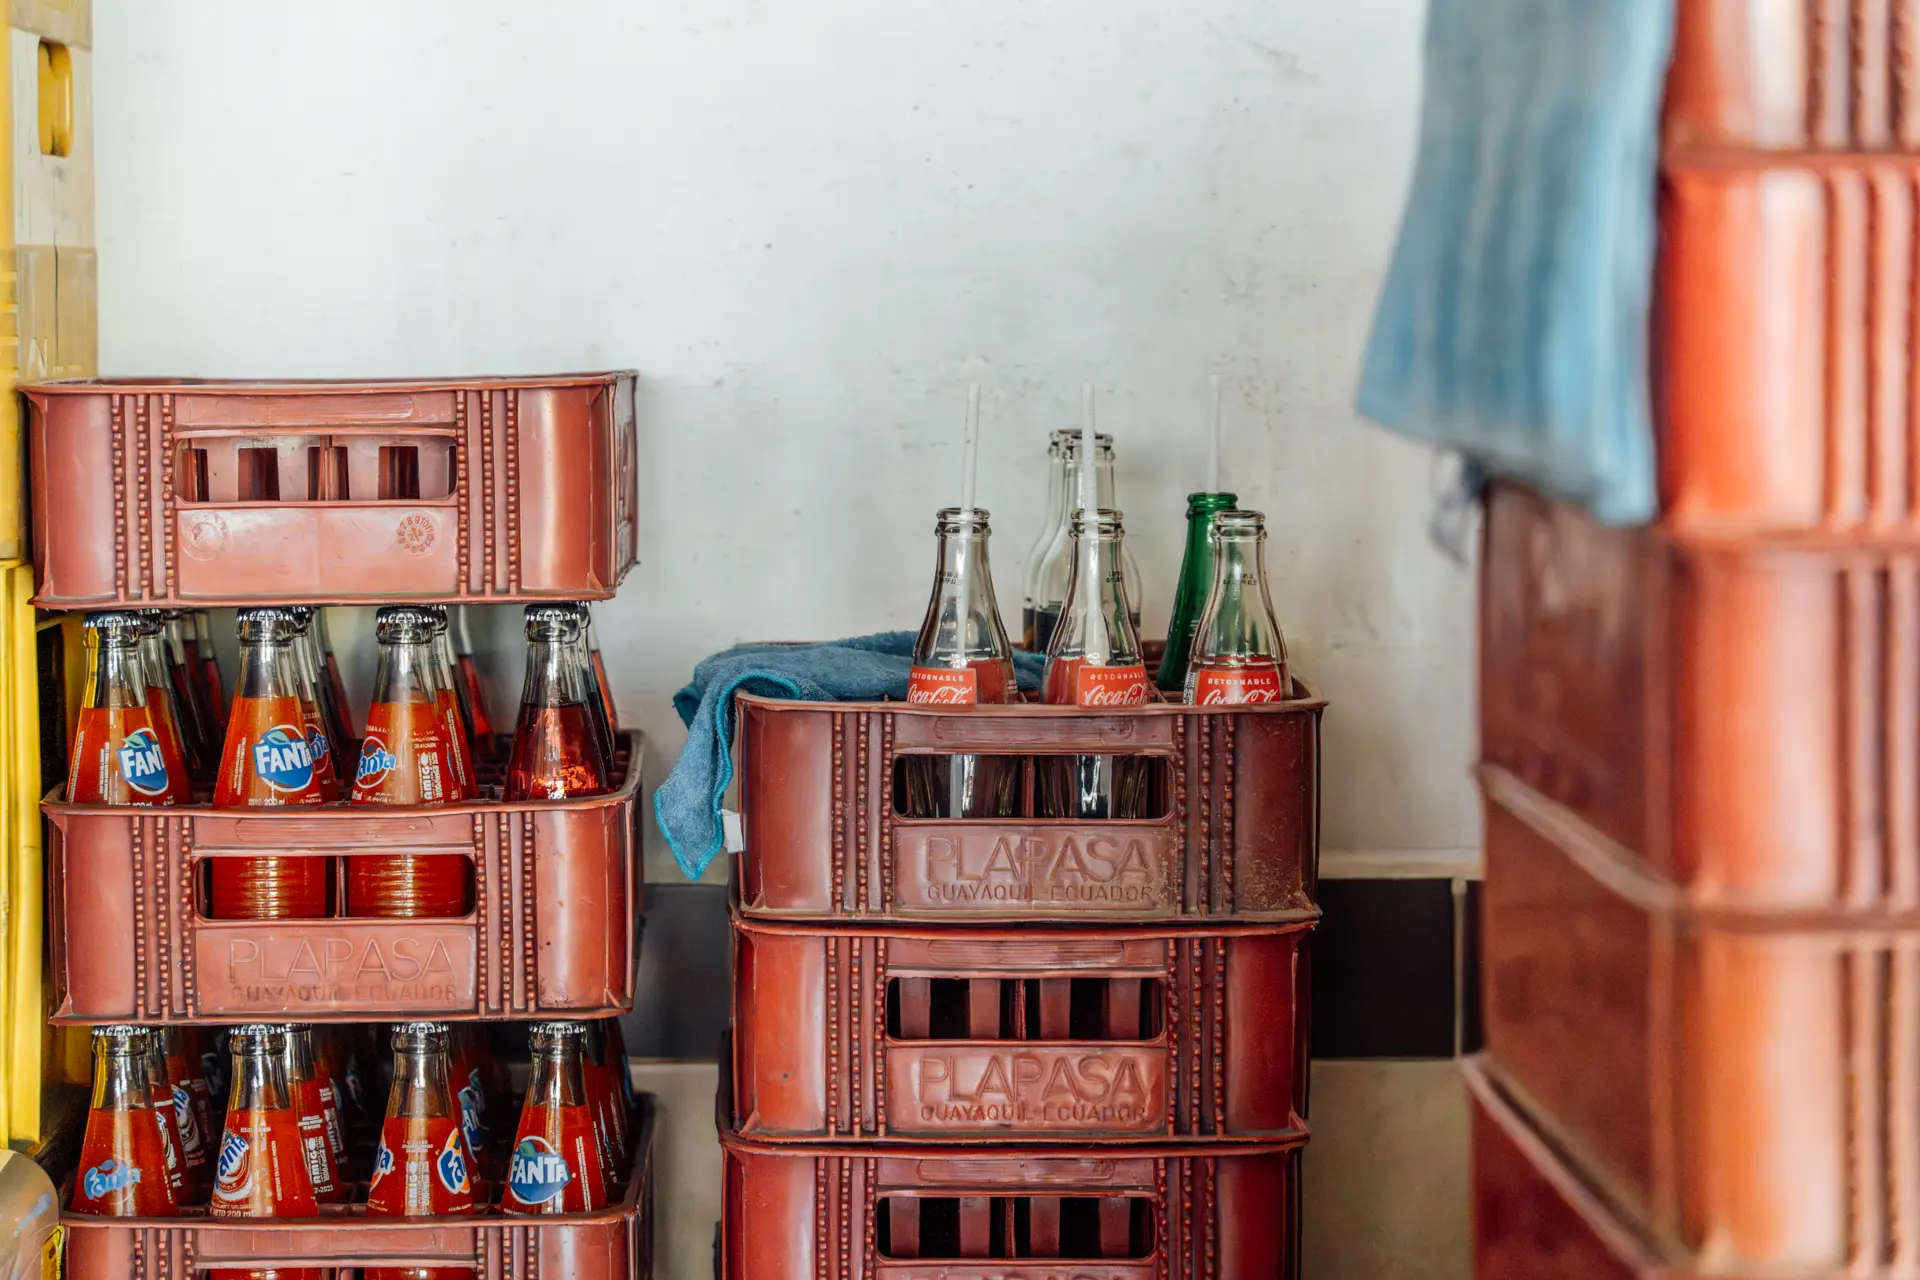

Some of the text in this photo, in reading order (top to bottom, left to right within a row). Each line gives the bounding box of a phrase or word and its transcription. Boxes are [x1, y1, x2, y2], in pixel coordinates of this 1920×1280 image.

[912, 672, 965, 681] RETORNABLE
[1090, 671, 1144, 680] RETORNABLE
[255, 741, 313, 774] FANTA
[357, 747, 396, 779] anta
[926, 835, 1151, 882] PLAPASA
[1050, 883, 1152, 901] ECUADOR
[229, 937, 456, 982] PLAPASA
[354, 983, 457, 1001] ECUADOR
[919, 1054, 1148, 1102] PLAPASA
[1042, 1103, 1147, 1121] ECUADOR
[219, 1135, 250, 1178] anta
[509, 1155, 569, 1185] FANTA
[84, 1163, 141, 1200] Fanta
